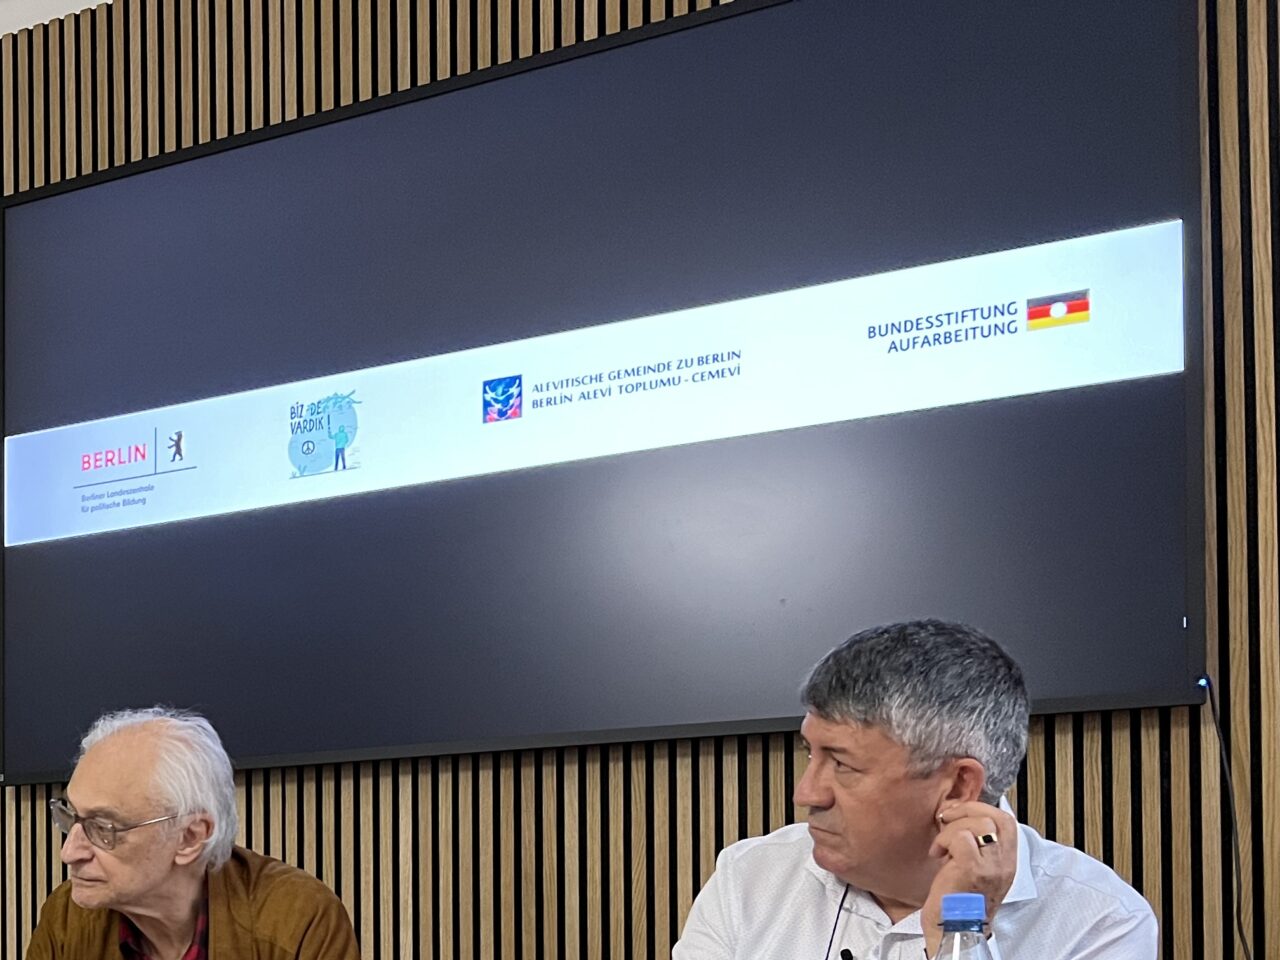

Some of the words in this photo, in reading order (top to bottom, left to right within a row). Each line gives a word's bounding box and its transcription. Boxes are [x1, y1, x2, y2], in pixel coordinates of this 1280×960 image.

[867, 301, 1018, 339] BUNDESSTIFTUNG
[887, 319, 1018, 354] AUFARBEITUNG
[531, 372, 604, 393] ALEVITISCHE
[608, 361, 673, 382] GEMEINDE
[676, 357, 694, 375] ZU
[697, 349, 742, 371] BERLIN
[617, 375, 682, 396] TOPLUMU
[81, 443, 147, 472] BERLIN
